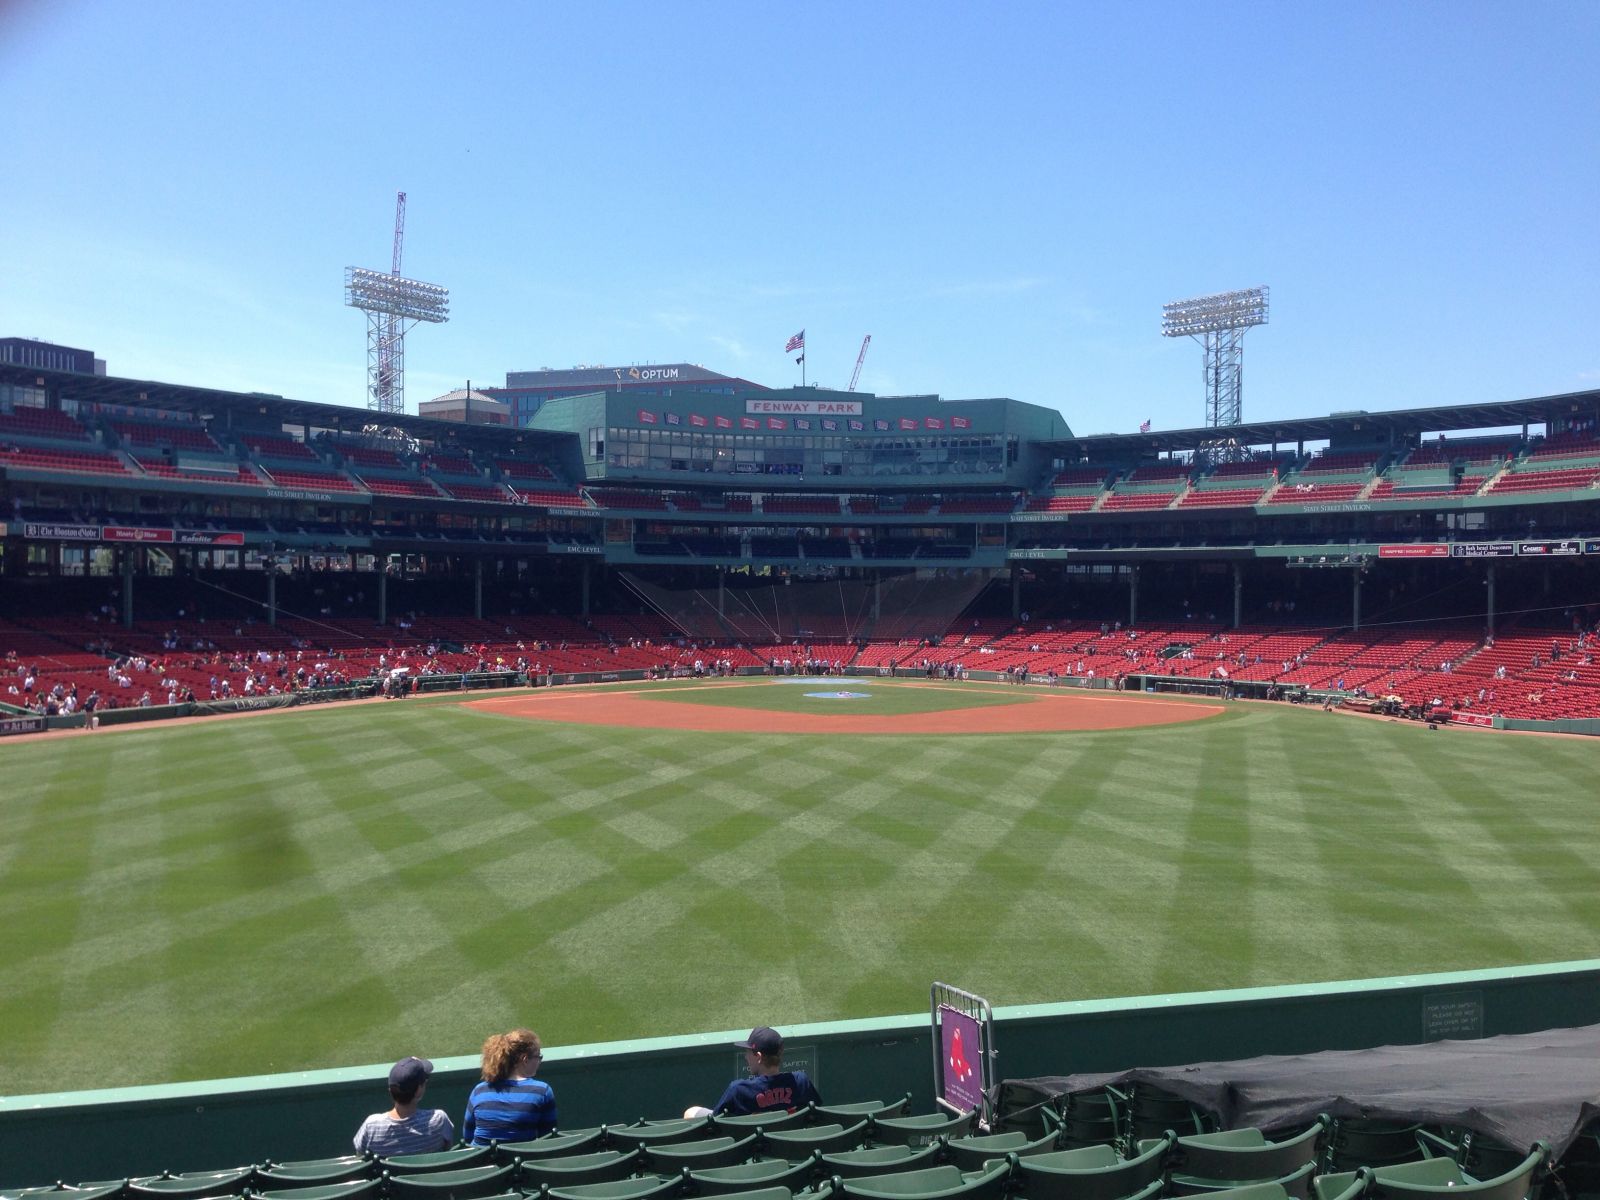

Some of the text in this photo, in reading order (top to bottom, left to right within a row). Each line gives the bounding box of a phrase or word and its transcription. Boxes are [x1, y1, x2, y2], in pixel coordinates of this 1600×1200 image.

[641, 368, 679, 379] OPTUM
[753, 402, 854, 412] FENWAY PARK
[284, 490, 304, 499] STREET
[40, 526, 96, 537] The Boston Globe
[783, 1060, 809, 1068] SAFETY
[756, 1087, 793, 1108] ORTIZ
